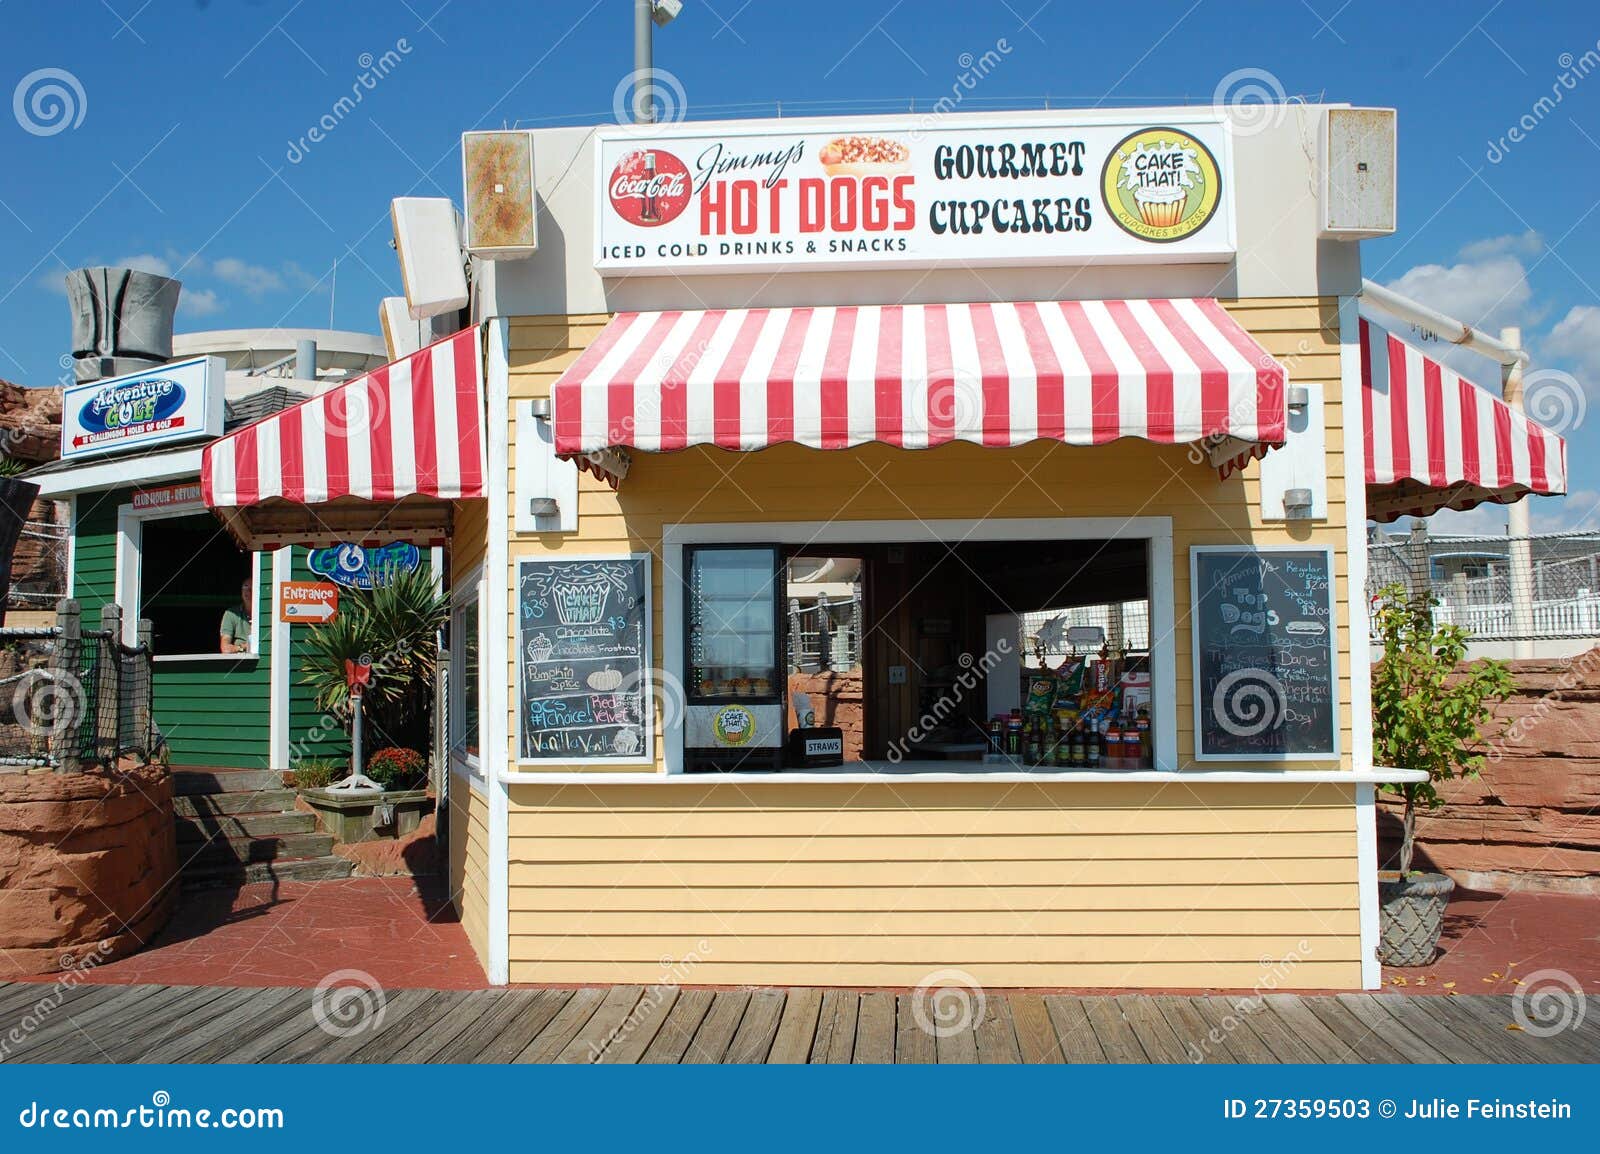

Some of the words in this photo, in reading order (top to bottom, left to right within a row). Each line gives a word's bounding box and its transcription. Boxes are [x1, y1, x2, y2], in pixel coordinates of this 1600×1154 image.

[694, 140, 806, 195] Jimmy's
[934, 141, 1086, 180] GOURMET
[1135, 152, 1184, 171] CAKE
[1136, 169, 1181, 188] THAT!
[700, 178, 788, 236] HOT
[800, 175, 915, 234] DOGS
[929, 197, 1092, 236] CUPCAKES
[1118, 211, 1168, 238] CUPCAKES
[1185, 208, 1208, 232] JESS
[603, 245, 646, 259] ICED
[658, 243, 708, 258] COLD
[720, 240, 794, 256] DRINKS
[806, 240, 817, 254] &
[829, 237, 907, 253] SNACKS
[92, 379, 173, 415] Adventure
[105, 396, 158, 428] GOLF
[127, 425, 145, 436] HOLES
[146, 423, 155, 432] OF
[156, 419, 172, 430] GOLF
[608, 616, 626, 630] $3
[598, 643, 637, 655] Frosting
[528, 665, 574, 681] Pumpkin
[724, 712, 744, 720] CAKE
[808, 742, 839, 752] STRAWS
